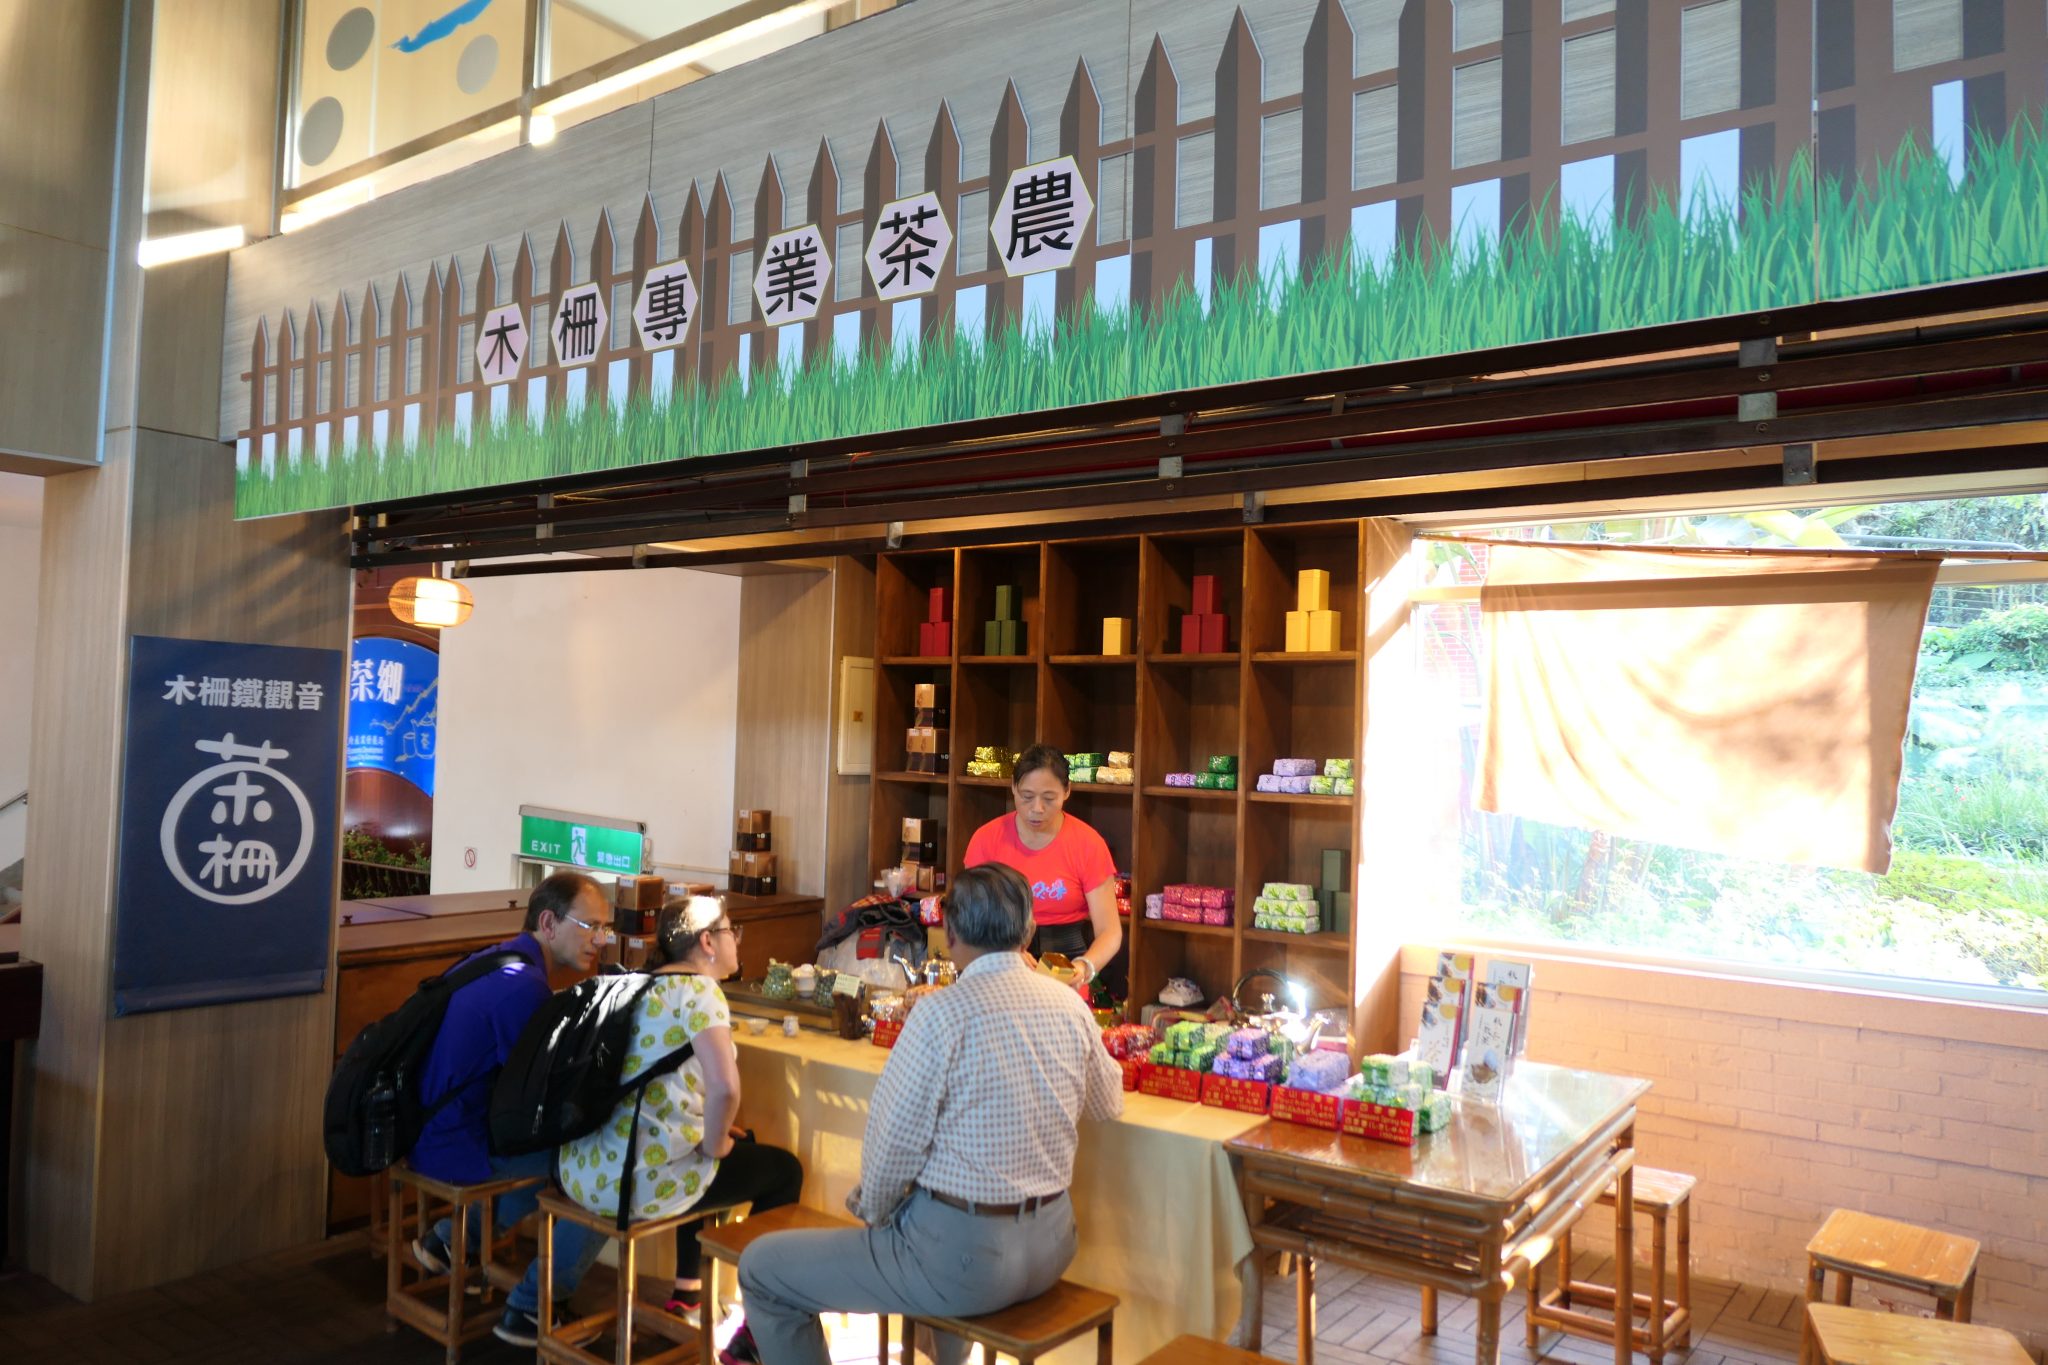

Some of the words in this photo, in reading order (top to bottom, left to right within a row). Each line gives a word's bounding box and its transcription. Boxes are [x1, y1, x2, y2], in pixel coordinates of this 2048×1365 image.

[483, 170, 1075, 376] 木柵專業茶農
[162, 674, 324, 711] 木柵鐵觀音
[531, 839, 561, 855] EXIT
